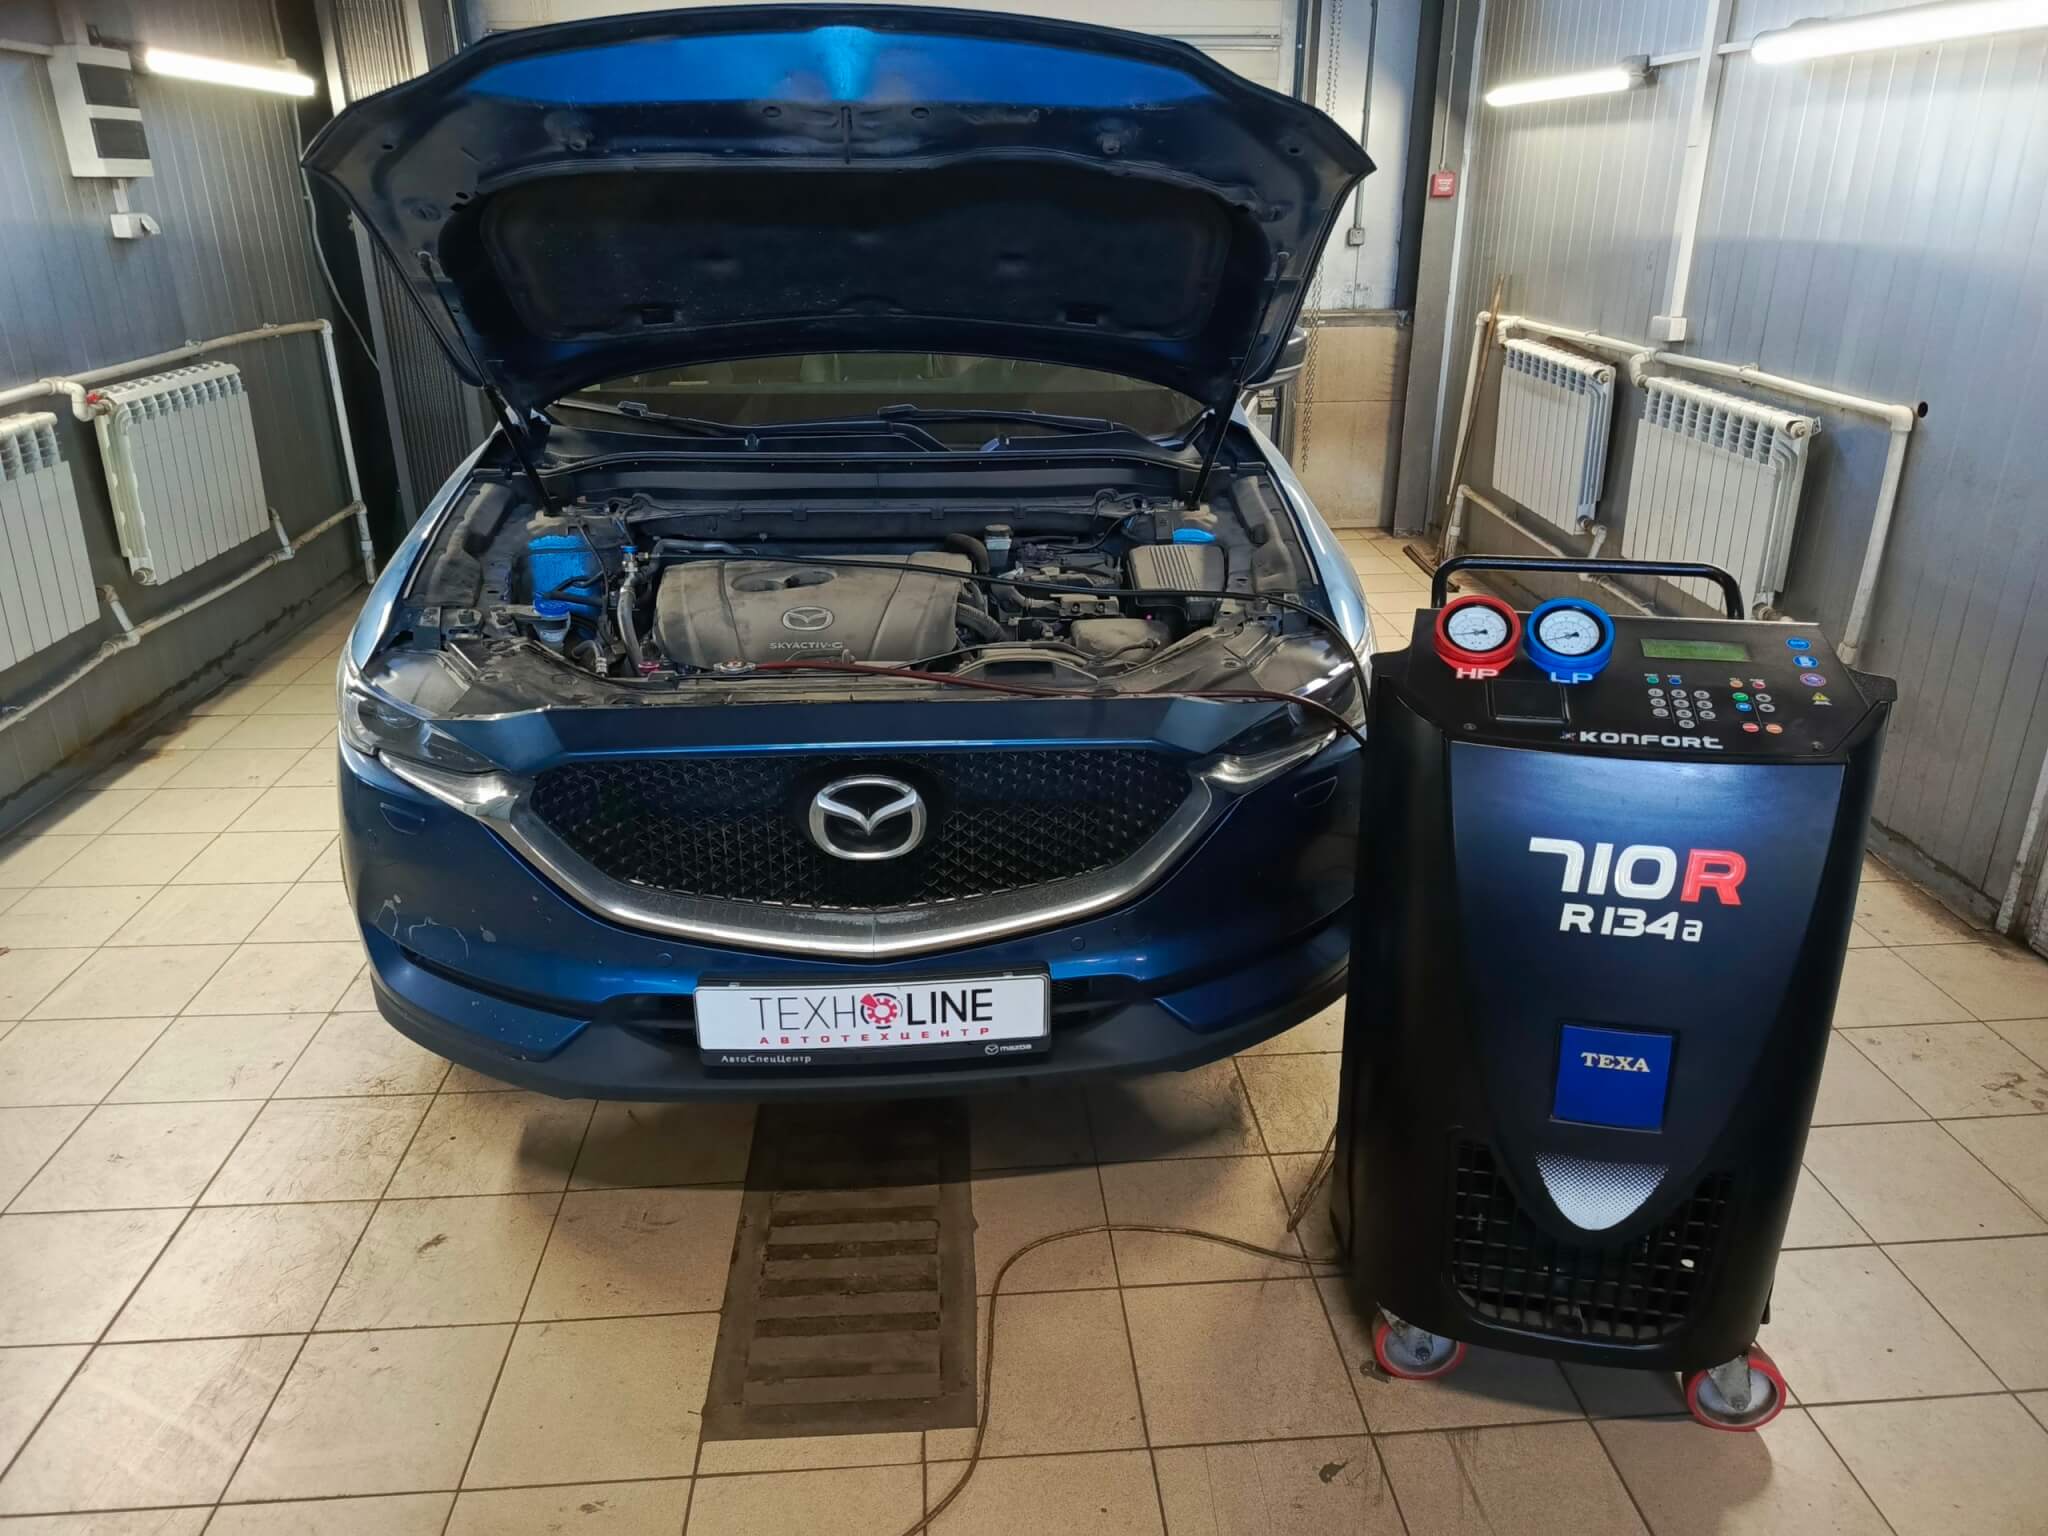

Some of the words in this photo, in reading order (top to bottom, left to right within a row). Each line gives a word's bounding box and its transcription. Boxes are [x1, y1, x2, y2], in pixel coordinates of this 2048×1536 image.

[1456, 667, 1499, 680] HP
[1550, 671, 1593, 685] LP
[1529, 837, 1747, 905] 710R
[759, 1027, 990, 1045] АВТОТЕХЦЕНТР
[1580, 1051, 1651, 1073] TEXA
